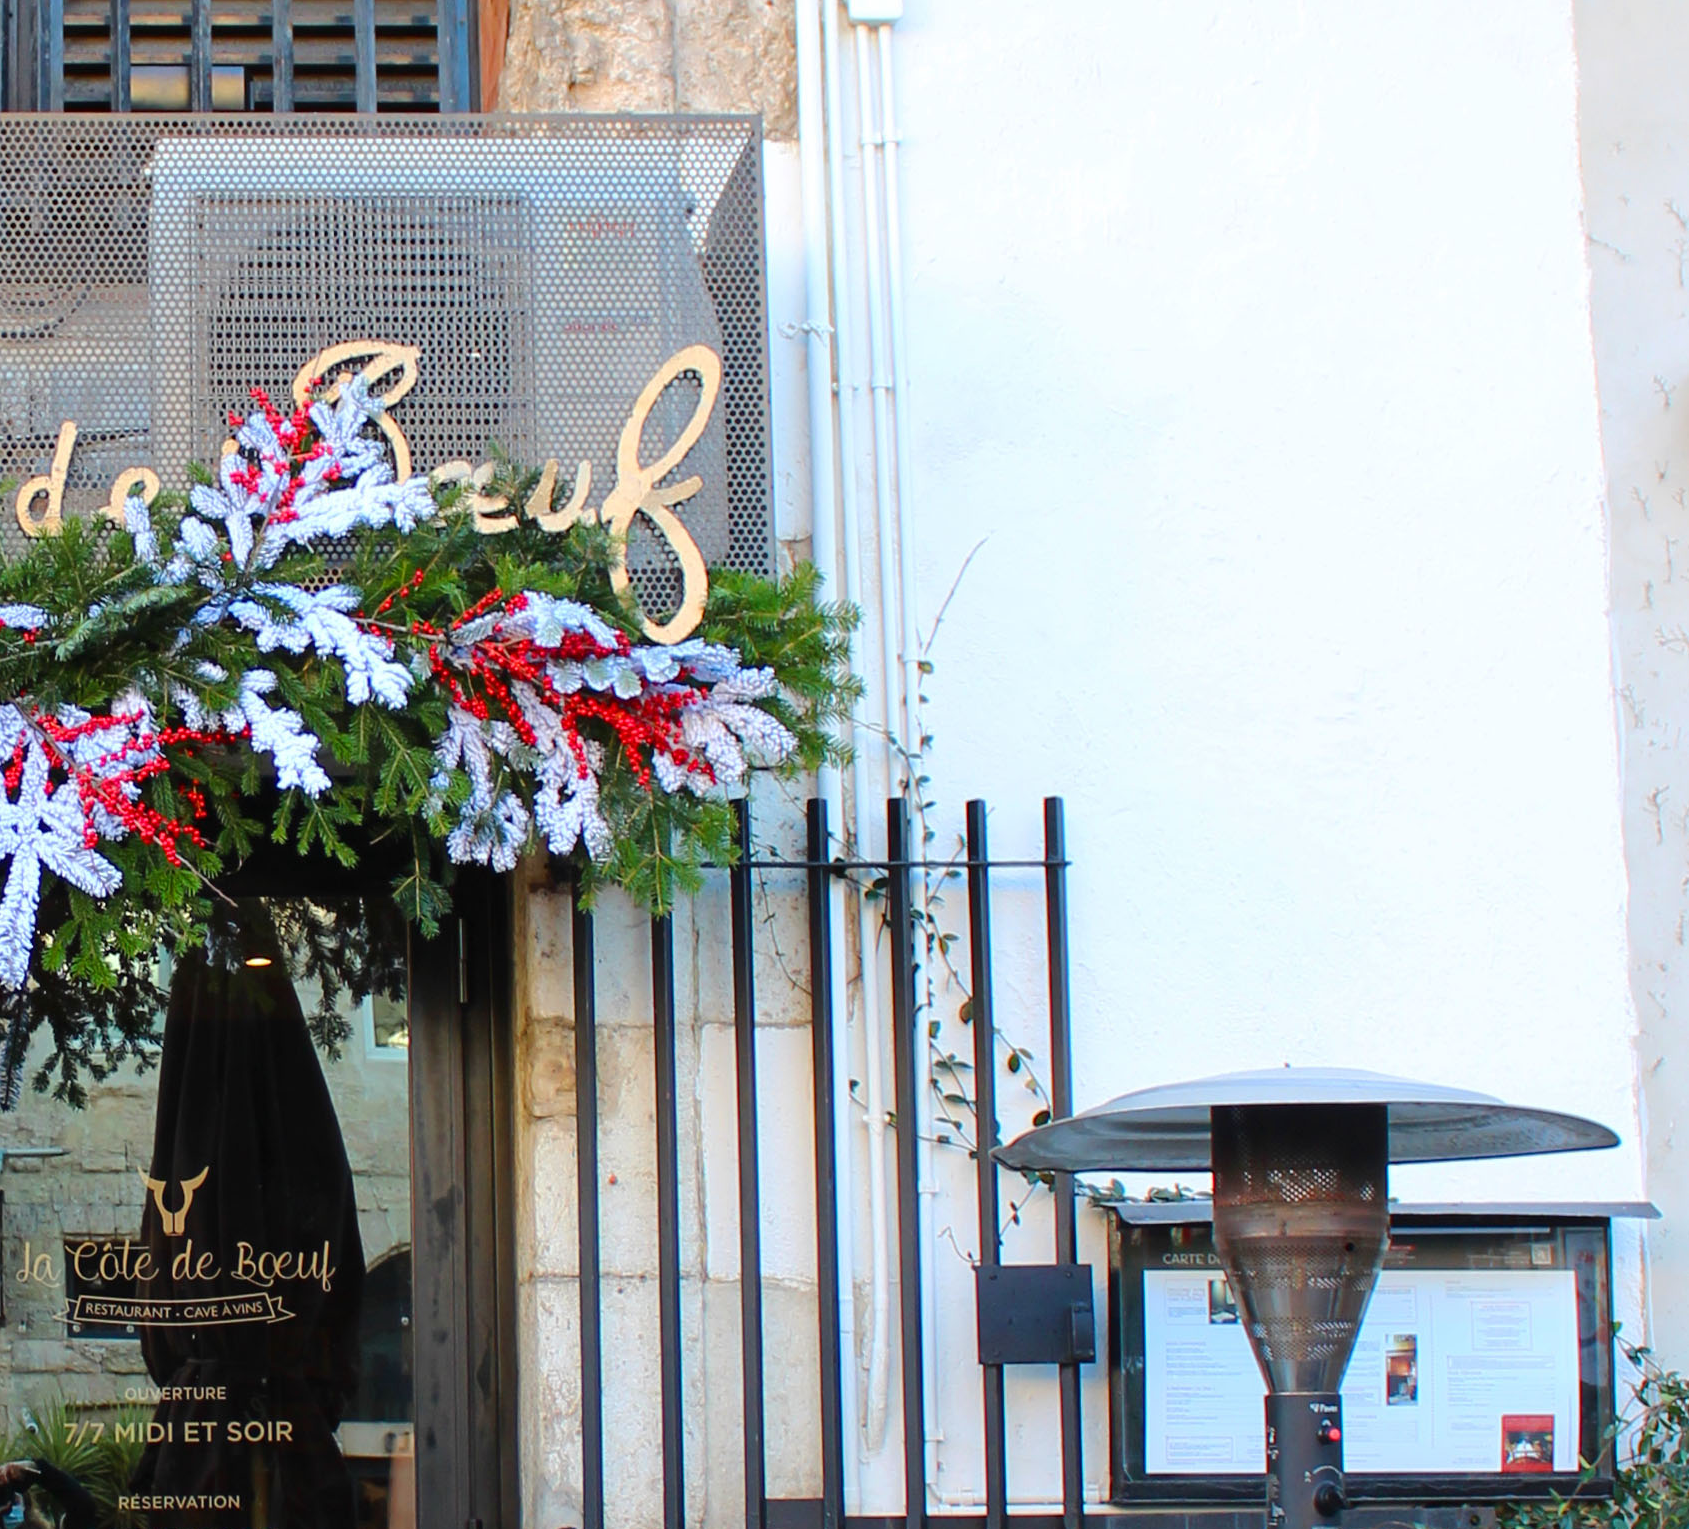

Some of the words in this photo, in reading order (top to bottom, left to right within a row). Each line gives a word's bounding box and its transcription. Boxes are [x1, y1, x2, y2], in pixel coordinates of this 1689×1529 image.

[15, 420, 159, 538] de
[16, 1240, 61, 1288] La
[64, 1238, 160, 1282] Côte
[171, 1238, 221, 1281] de
[1162, 1253, 1205, 1266] CARTE
[85, 1302, 171, 1320] RESTAURANT
[183, 1305, 219, 1319] CAVE
[232, 1301, 264, 1315] VINS
[124, 1386, 227, 1401] OUVERTURE
[62, 1421, 105, 1447] 7/7
[114, 1422, 174, 1443] MIDI
[183, 1421, 218, 1443] ET
[226, 1421, 294, 1443] SOIR
[117, 1492, 241, 1510] RÉSERVATION
